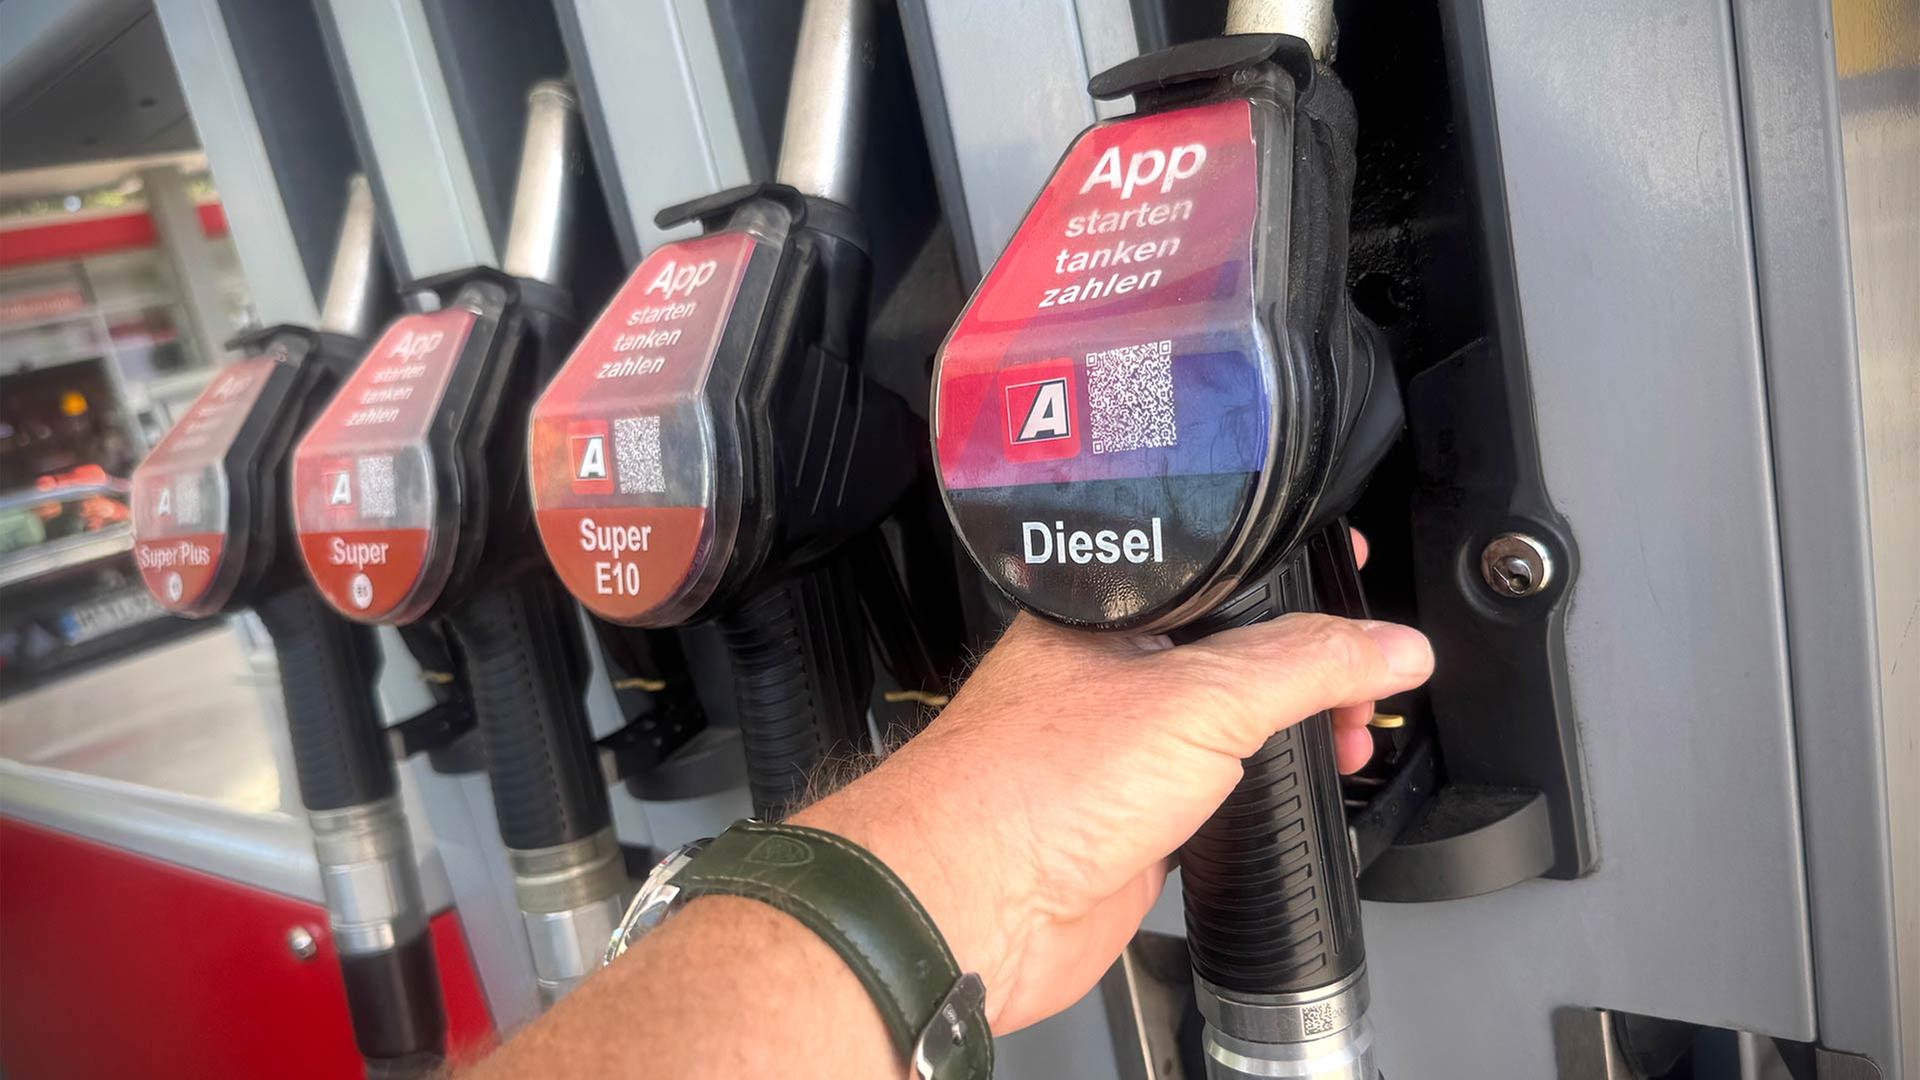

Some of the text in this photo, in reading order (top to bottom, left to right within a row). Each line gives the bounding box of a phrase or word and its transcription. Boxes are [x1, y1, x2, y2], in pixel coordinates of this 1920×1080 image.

[1079, 143, 1207, 199] App
[1065, 200, 1193, 238] starten
[1055, 236, 1180, 274] tanken
[646, 259, 717, 299] App
[1039, 268, 1161, 308] zahlen
[628, 302, 696, 326] starten
[389, 331, 444, 361] App
[613, 329, 682, 353] tanken
[373, 364, 426, 384] starten
[597, 355, 665, 379] zahlen
[361, 385, 413, 405] tanken
[1018, 380, 1069, 440] A
[346, 406, 399, 427] zahlen
[579, 437, 606, 477] A
[157, 488, 171, 516] A
[331, 472, 351, 505] A
[332, 537, 389, 570] Super
[580, 518, 651, 560] Super
[1022, 517, 1163, 564] Diesel
[141, 541, 210, 572] Super Plus
[595, 562, 640, 596] E10
